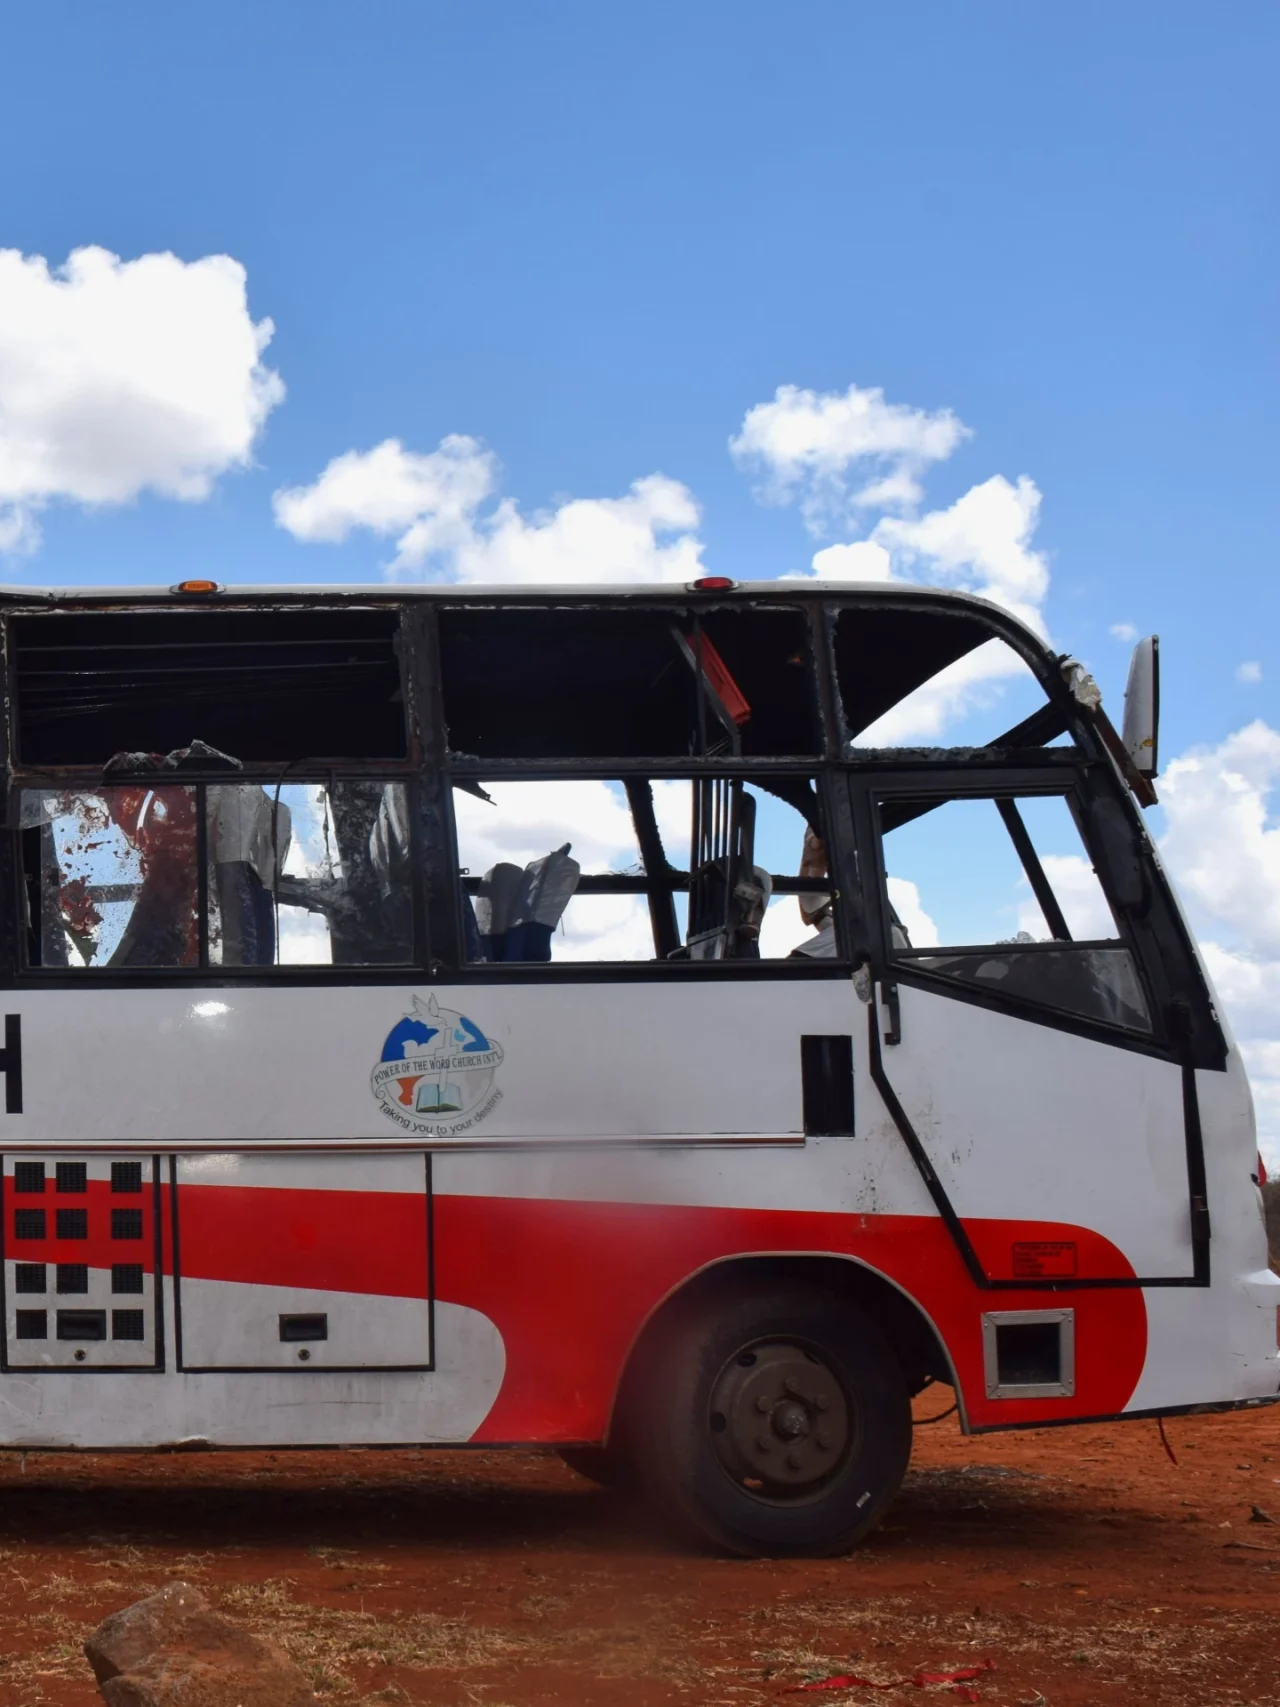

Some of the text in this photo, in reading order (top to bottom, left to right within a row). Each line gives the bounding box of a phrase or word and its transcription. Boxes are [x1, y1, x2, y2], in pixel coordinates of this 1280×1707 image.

[374, 1063, 401, 1085] POWER
[401, 1063, 411, 1073] OF
[413, 1060, 428, 1071] THE
[429, 1058, 451, 1070] WORD
[451, 1056, 482, 1069] CHURCH
[378, 1087, 504, 1135] Taking you to your destiny
